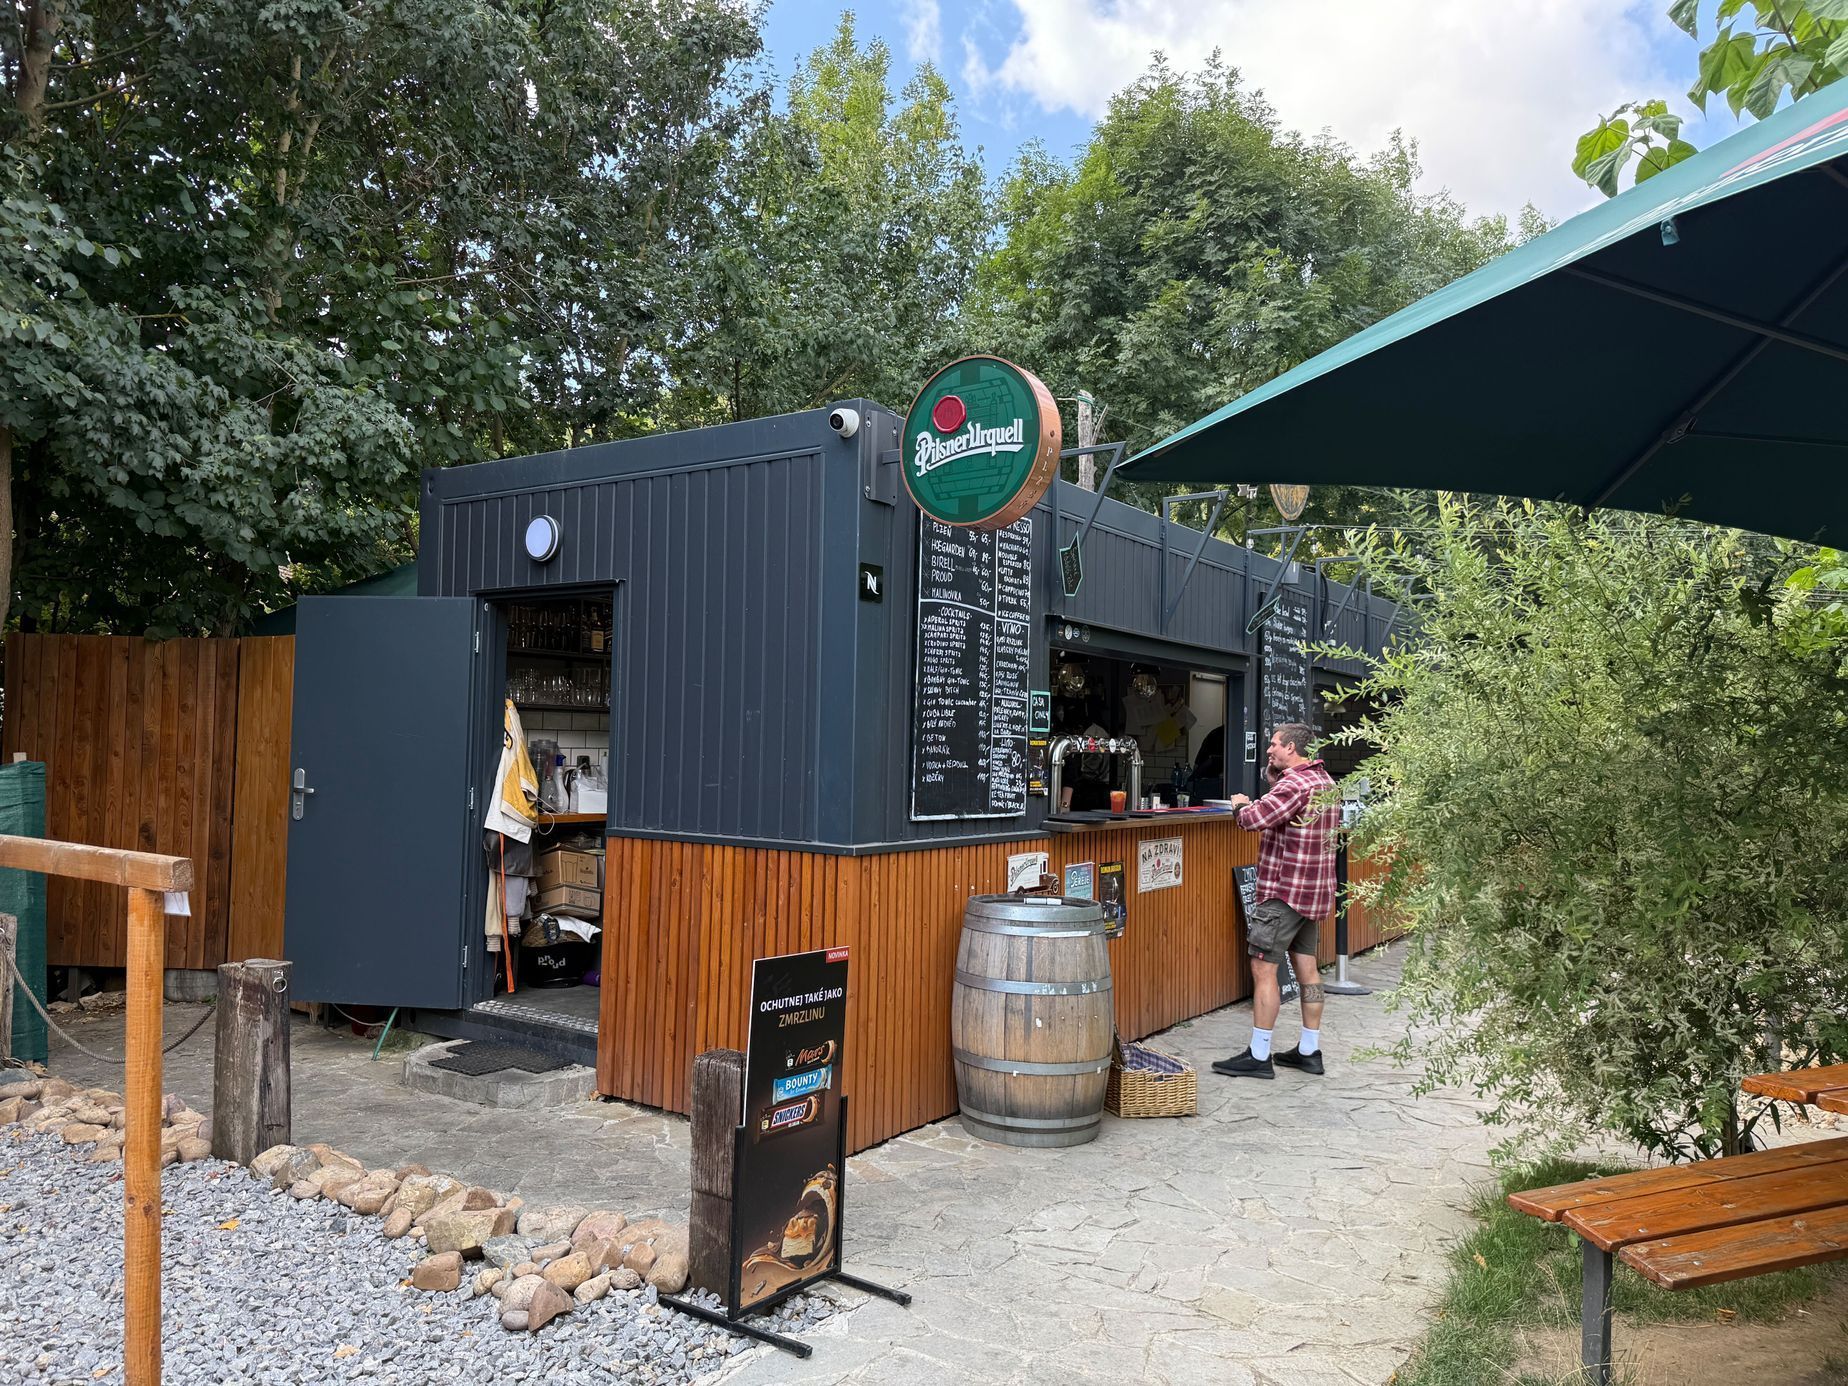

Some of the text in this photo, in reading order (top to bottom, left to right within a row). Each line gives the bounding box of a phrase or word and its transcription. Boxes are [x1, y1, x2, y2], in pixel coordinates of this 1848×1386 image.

[914, 418, 1024, 477] Pilsner Urquell
[931, 555, 956, 572] BIRELL
[931, 568, 953, 582] PROUD
[1001, 620, 1022, 635] VÍNO
[1141, 848, 1153, 864] NA
[537, 955, 566, 969] proud
[760, 987, 843, 1012] OCHUTNEJ TAKÉ JAKO
[778, 1006, 825, 1028] ZMRZLINU
[795, 1045, 826, 1067] Mars
[785, 1072, 818, 1091] BOUNTY
[773, 1104, 807, 1125] SNICKERS
